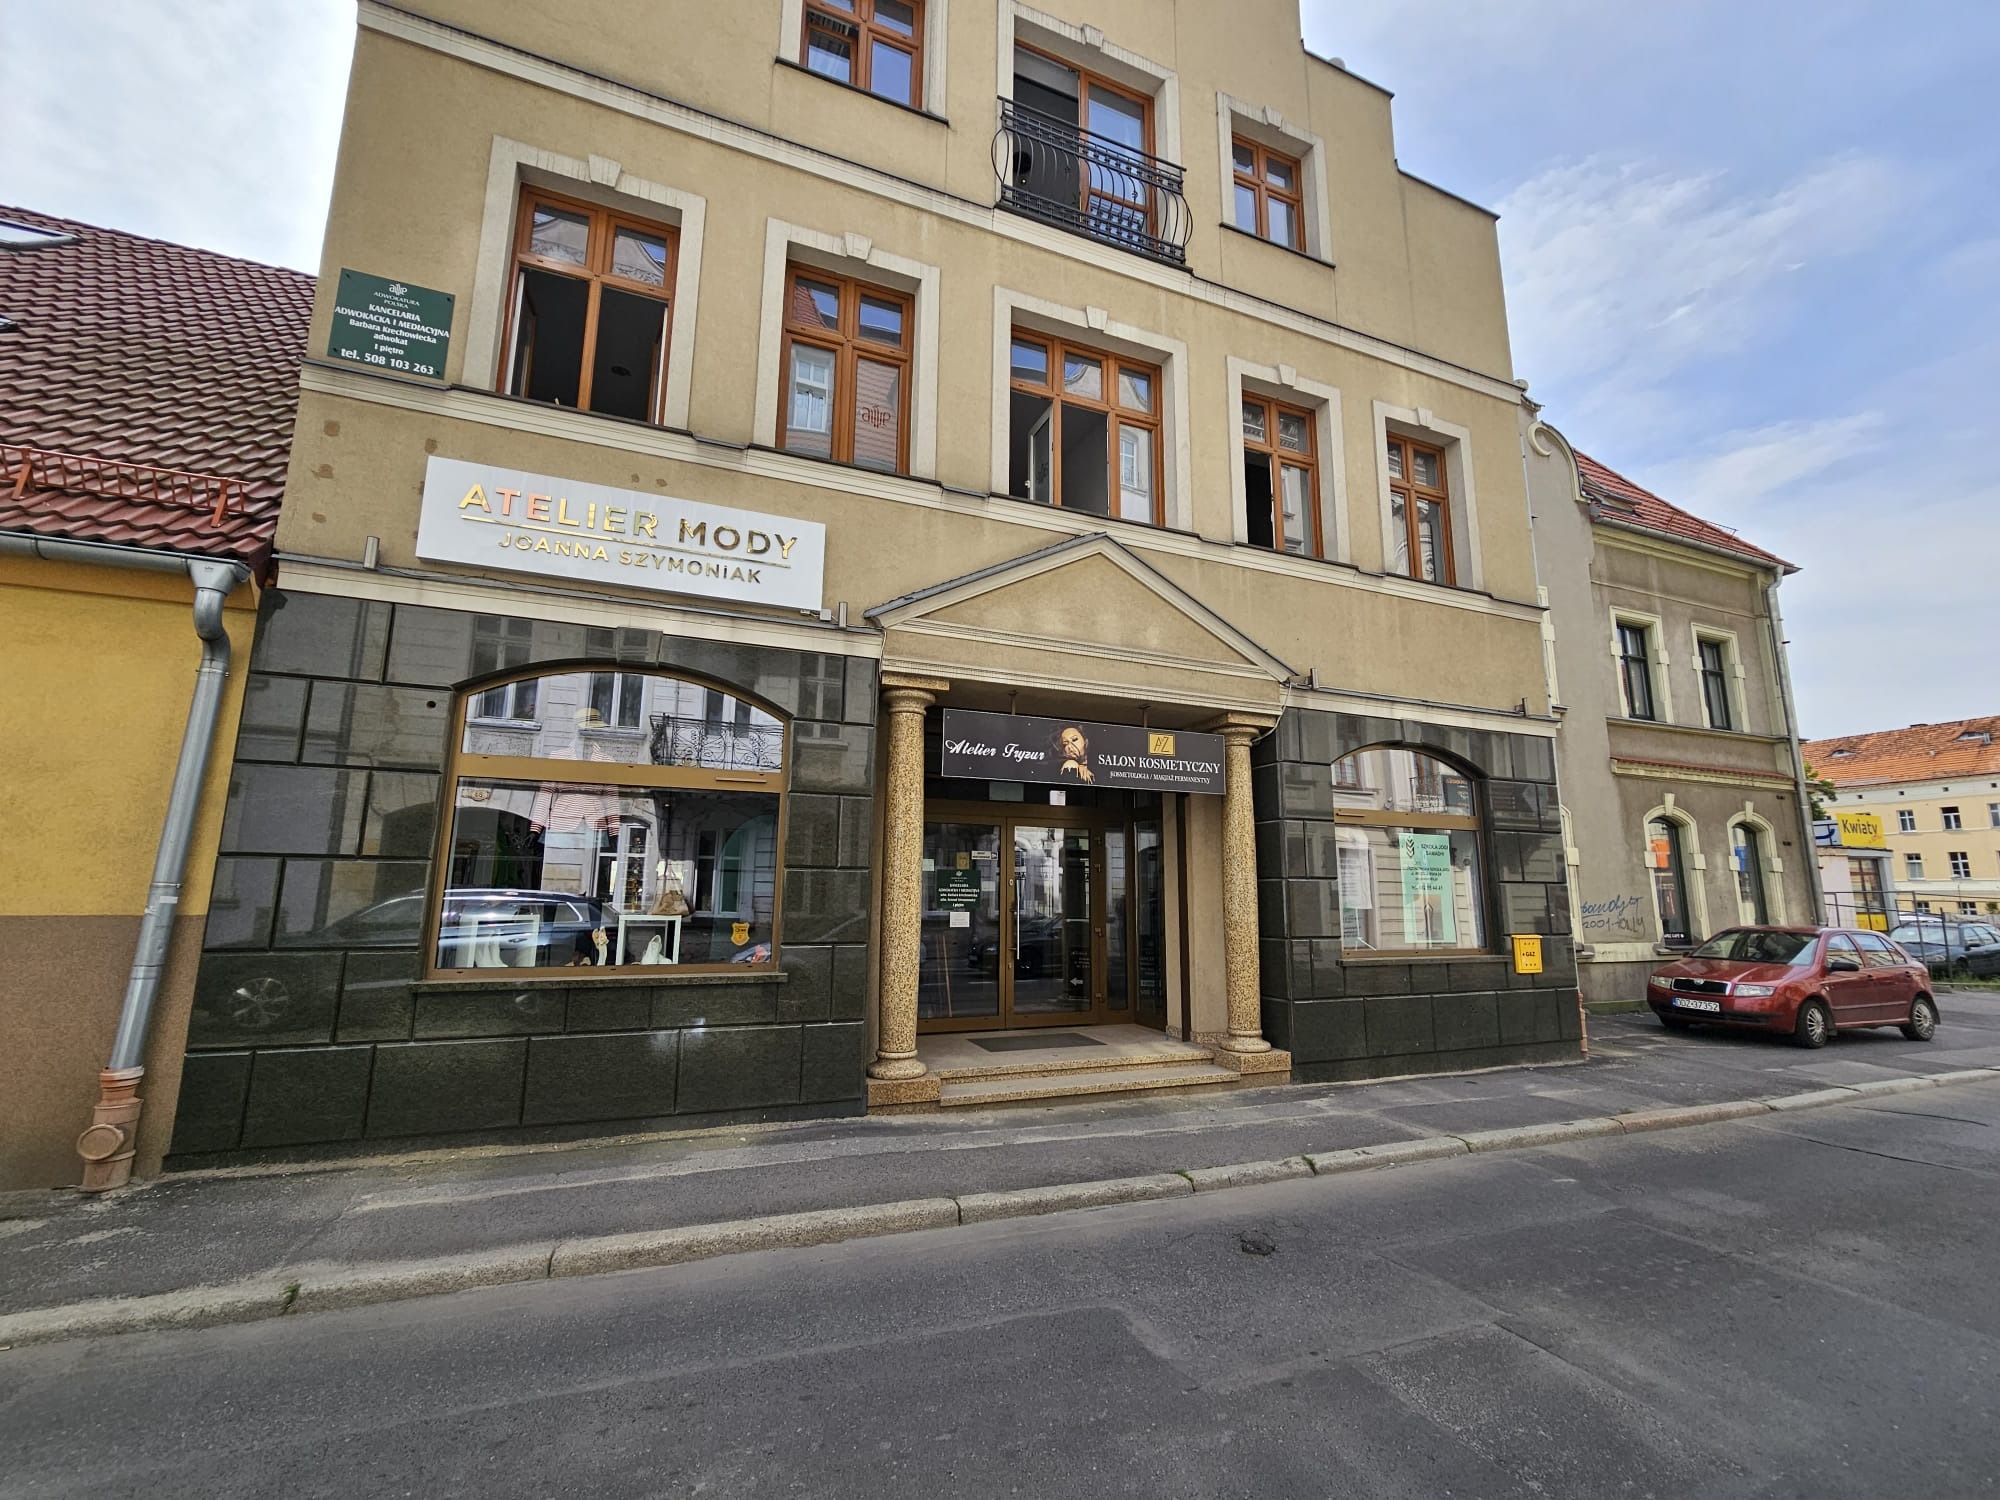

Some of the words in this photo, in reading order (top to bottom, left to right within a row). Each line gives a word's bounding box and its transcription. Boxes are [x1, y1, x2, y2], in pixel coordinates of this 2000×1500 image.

[374, 291, 420, 306] ADWOKATURA
[383, 299, 409, 309] POLSKA
[368, 303, 421, 322] KANCELARIA
[334, 306, 391, 326] ADWOKACKA
[398, 320, 450, 338] MEDIACYJNA
[349, 318, 381, 332] Barbara
[382, 326, 437, 344] Krechowiecka
[373, 333, 409, 346] adwokat
[379, 344, 404, 355] piętro
[340, 348, 361, 360] tel.
[364, 352, 386, 365] 508
[390, 358, 410, 370] 103
[413, 363, 434, 375] 263
[458, 483, 660, 539] ATELIER
[678, 518, 799, 561] MODY
[498, 532, 610, 562] JOANNA
[945, 739, 997, 757] Atelier
[1098, 753, 1137, 768] SALON
[1139, 757, 1221, 775] KOSMETYCZNY
[1110, 770, 1150, 780] KOSMETOLOGIA
[1174, 775, 1210, 785] PERMANENTNY
[1841, 818, 1878, 836] Kwiaty
